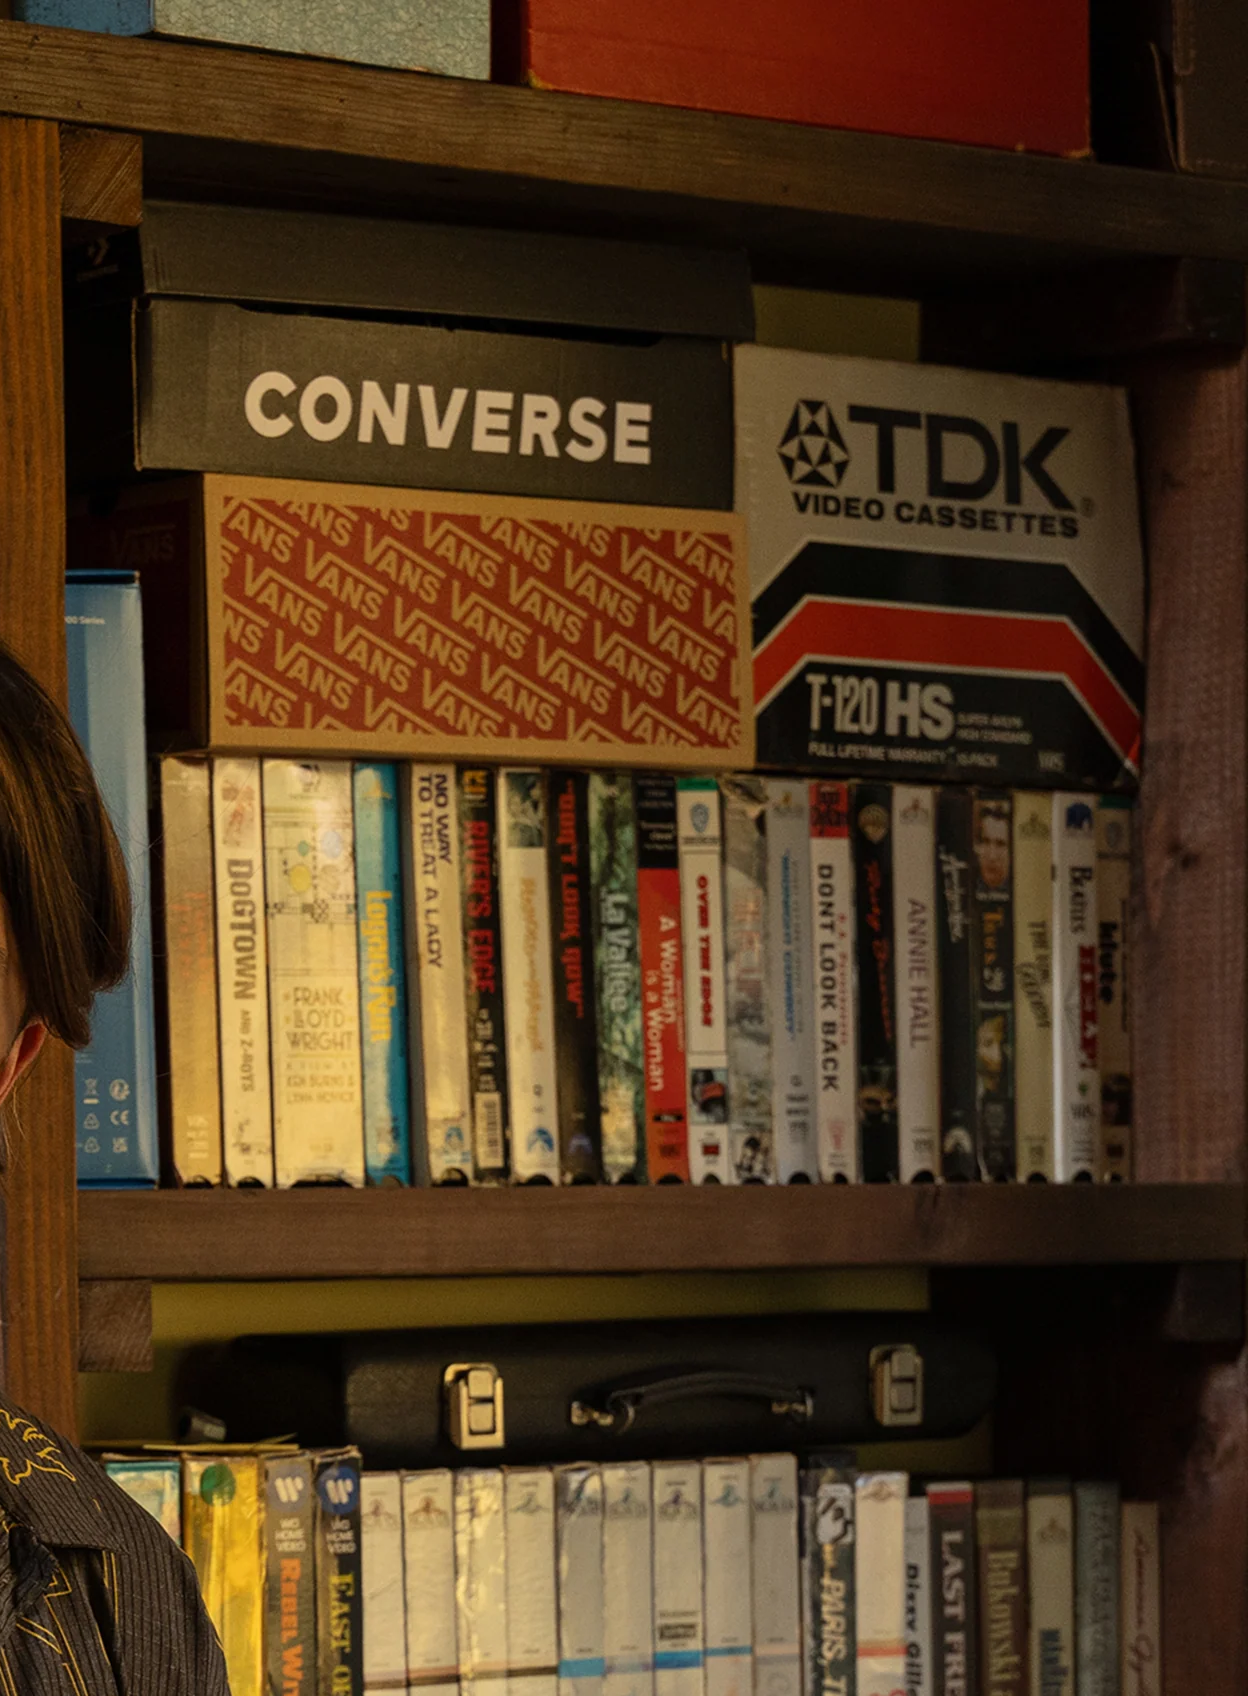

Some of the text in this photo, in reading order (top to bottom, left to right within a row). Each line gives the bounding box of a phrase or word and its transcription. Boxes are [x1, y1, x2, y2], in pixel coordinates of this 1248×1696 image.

[243, 370, 652, 466] CONVERSE
[848, 404, 1076, 513] TDK
[423, 512, 503, 589] VANS
[791, 491, 1079, 538] VIDEO CASSETTES
[244, 555, 328, 637] VANS
[305, 539, 388, 621] VANS
[363, 523, 446, 604] VANS
[508, 564, 588, 644] VANS
[564, 550, 643, 627] VANS
[621, 535, 697, 612] VANS
[334, 612, 417, 693] VANS
[393, 597, 475, 677] VANS
[451, 582, 532, 660] VANS
[594, 620, 672, 699] VANS
[648, 605, 726, 682] VANS
[274, 630, 360, 710] VANS
[481, 653, 560, 731] VANS
[537, 637, 616, 714] VANS
[806, 673, 955, 740] T-120 HS
[808, 741, 835, 757] FULL
[838, 744, 885, 761] LIFETIME
[434, 774, 453, 865] NO WAY
[417, 774, 443, 968] TO TREAT A LADY
[463, 819, 492, 918] RIVER'S
[605, 892, 631, 924] La
[227, 858, 257, 1001] DOGTOWN
[360, 890, 397, 1043] Logan's Run
[467, 929, 496, 995] EDGE
[659, 915, 678, 1025] A Woman
[697, 876, 714, 1028] OVER THE EDGE
[293, 986, 344, 1007] FRANK
[817, 863, 839, 1092] DONT LOOK BACK
[906, 898, 931, 1049] ANNIE HALL
[285, 1030, 355, 1052] WRIGHT
[645, 969, 666, 1092] is a Woman
[278, 1557, 303, 1644] REBEL
[329, 1571, 354, 1651] EAST
[940, 1529, 965, 1623] LAST
[987, 1549, 1021, 1682] Bukowski
[819, 1577, 847, 1667] PARIS,
